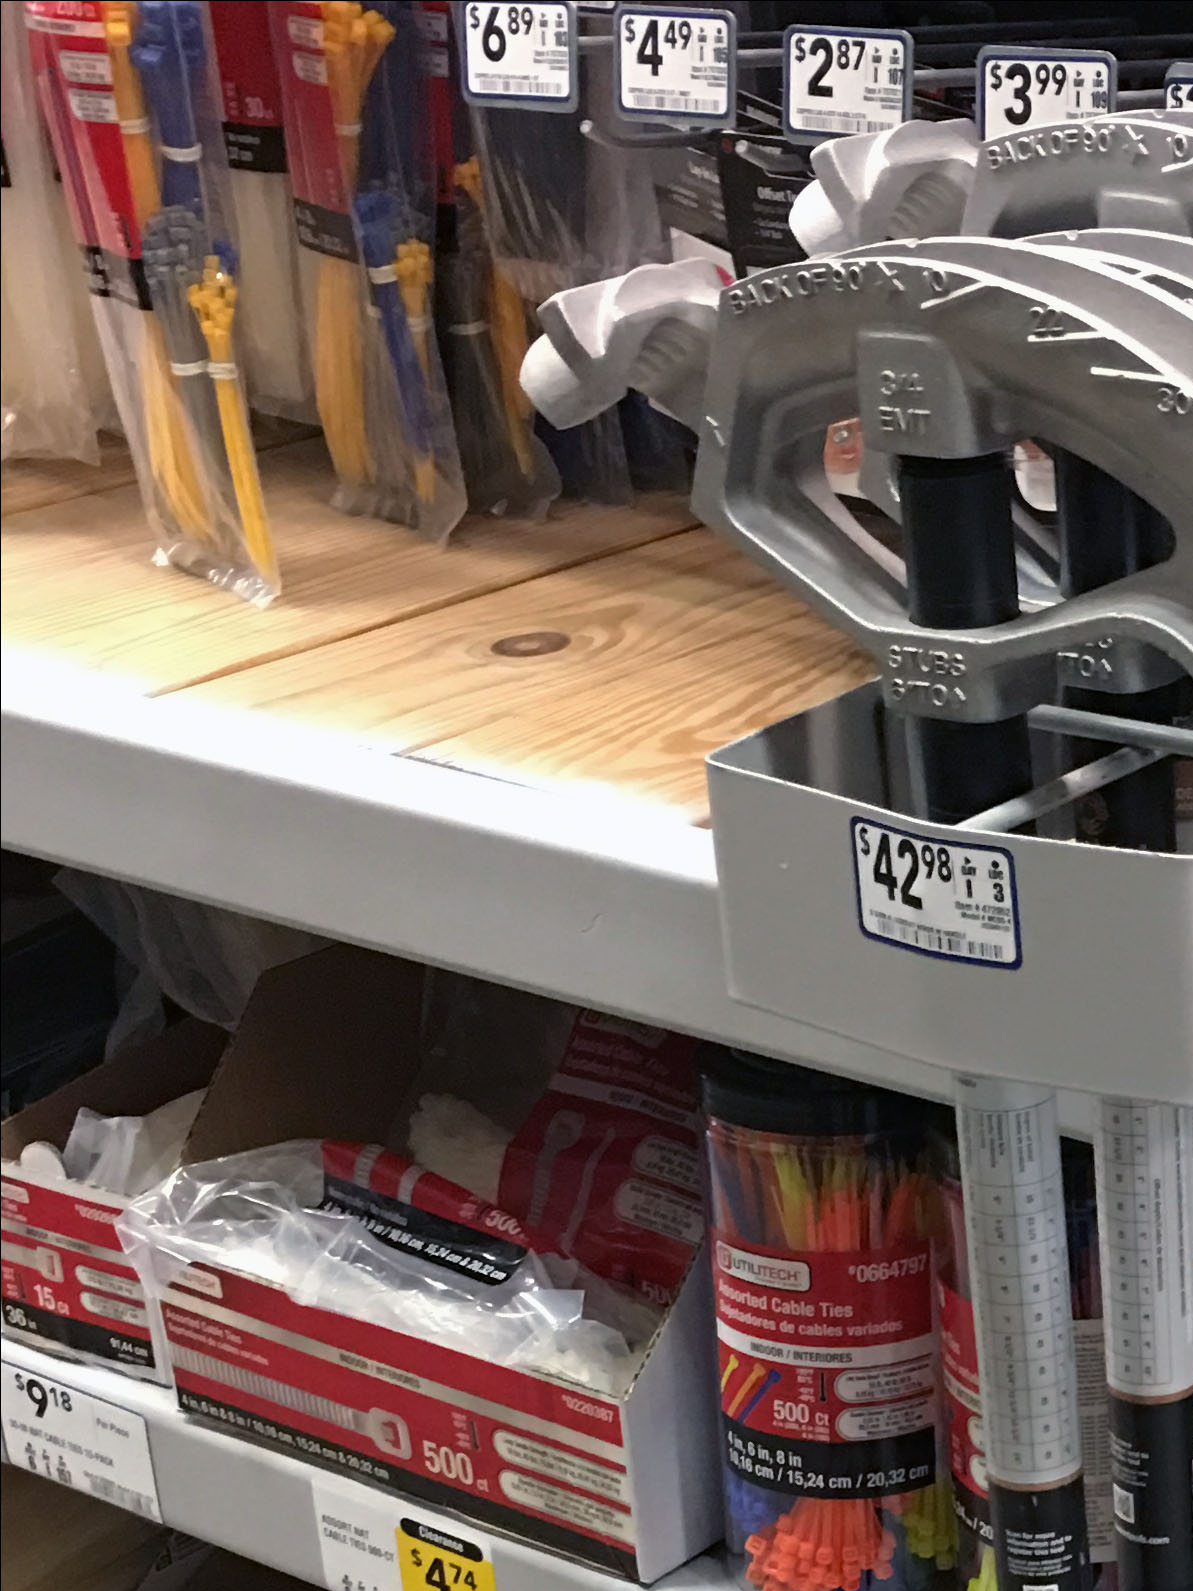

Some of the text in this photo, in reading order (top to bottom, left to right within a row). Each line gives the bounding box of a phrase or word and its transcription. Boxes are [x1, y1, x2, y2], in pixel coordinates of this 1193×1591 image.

[1029, 305, 1064, 338] 22
[1156, 387, 1193, 415] 30
[993, 883, 1004, 902] 3
[34, 1284, 55, 1310] 15
[719, 1280, 853, 1318] Assorted Cable Ties
[6, 1305, 27, 1326] 36
[779, 1319, 795, 1333] de
[798, 1323, 843, 1337] cables
[846, 1320, 902, 1337] variados
[751, 1342, 852, 1363] INDOOR INTERIORES
[773, 1400, 809, 1422] 500
[422, 1440, 473, 1484] 500
[788, 1453, 802, 1467] in
[755, 1464, 928, 1489] cm 15,24 cm 20,32 cm
[419, 1525, 464, 1552] Clearance
